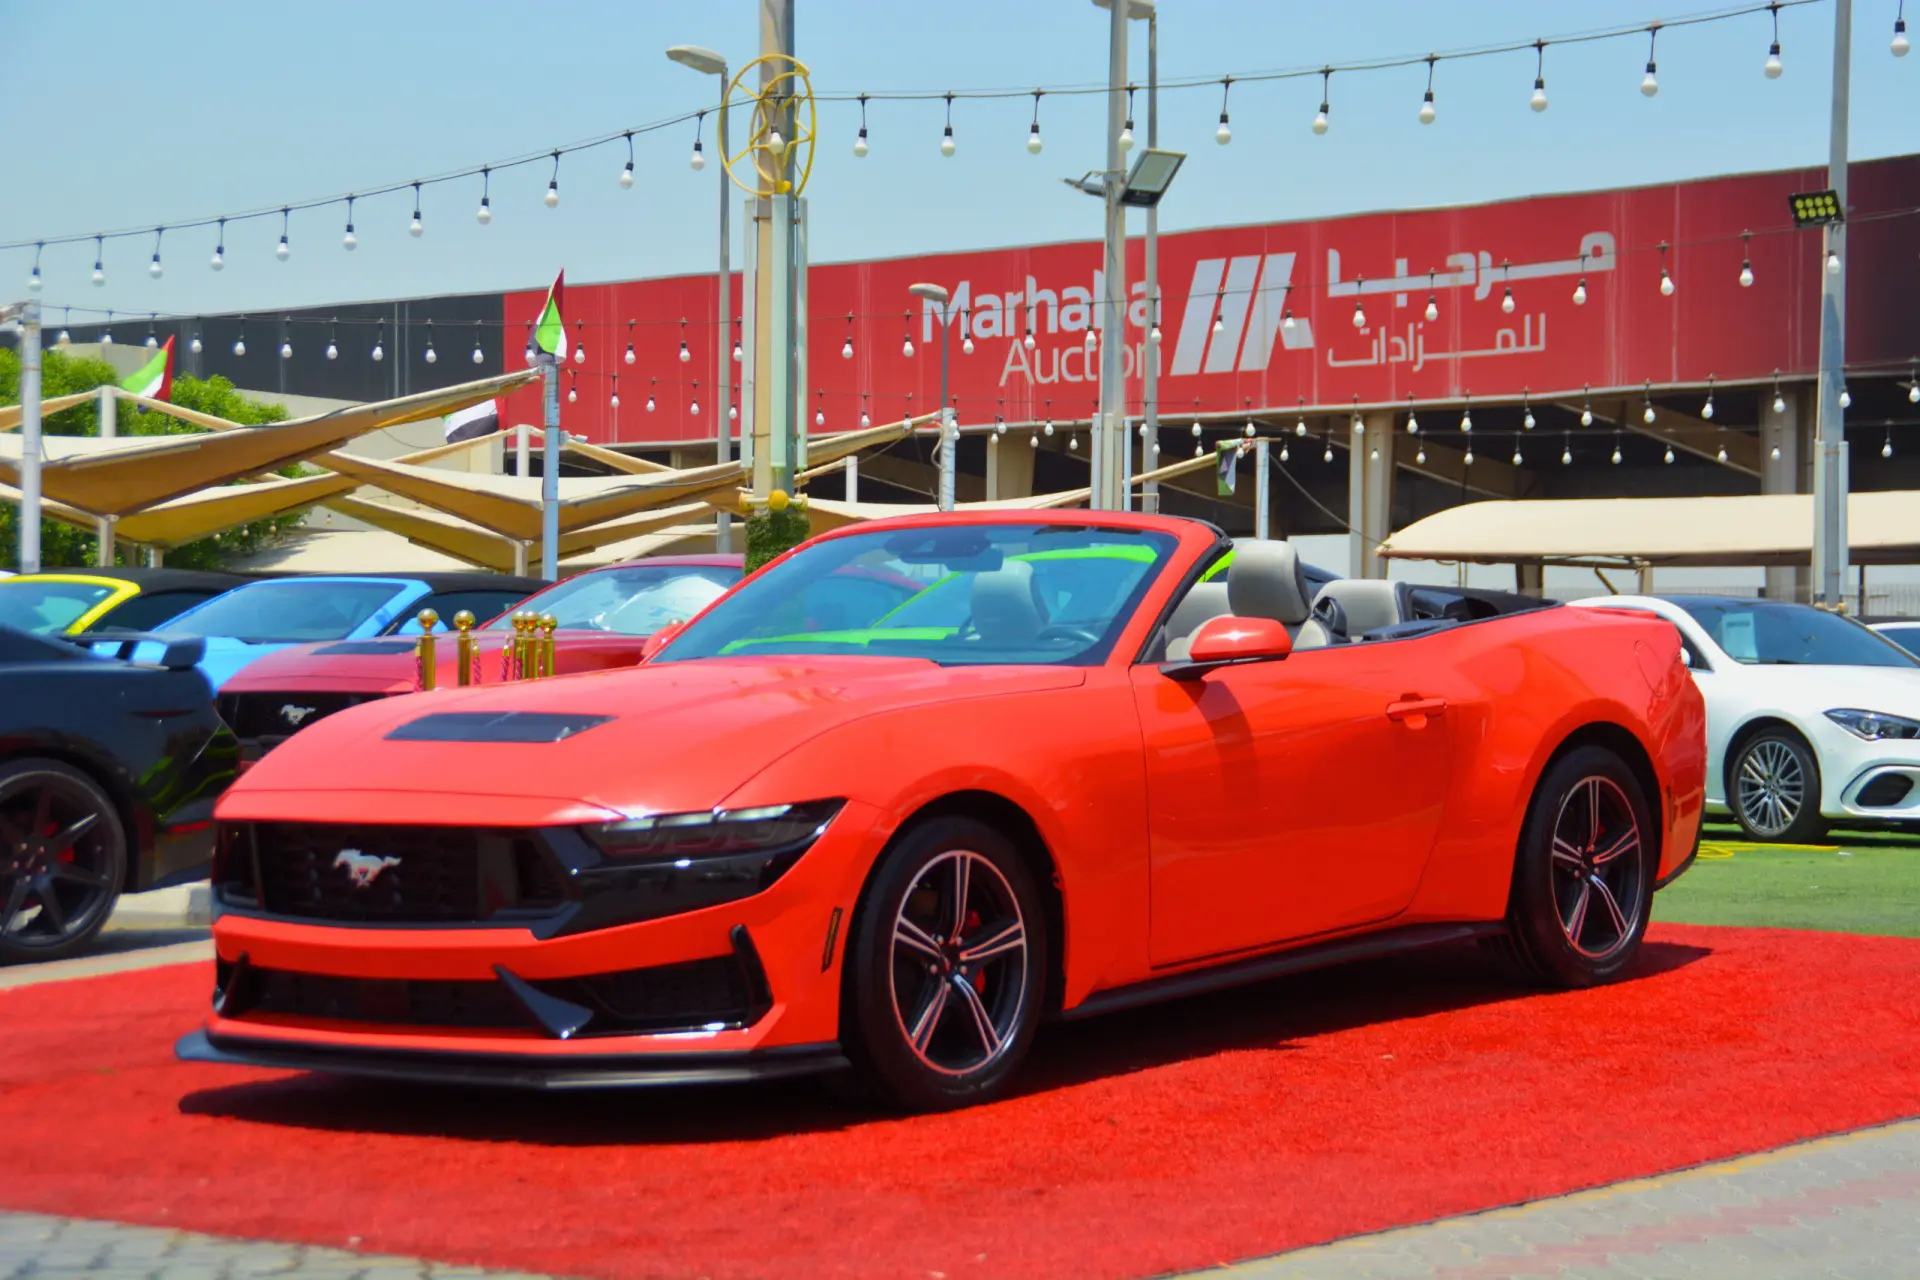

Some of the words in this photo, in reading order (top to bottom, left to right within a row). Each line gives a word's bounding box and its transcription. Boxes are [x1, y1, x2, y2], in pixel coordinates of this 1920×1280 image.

[1328, 232, 1616, 307] مرحبا
[1000, 339, 1161, 386] Auctn
[1328, 313, 1546, 372] للمزادات
